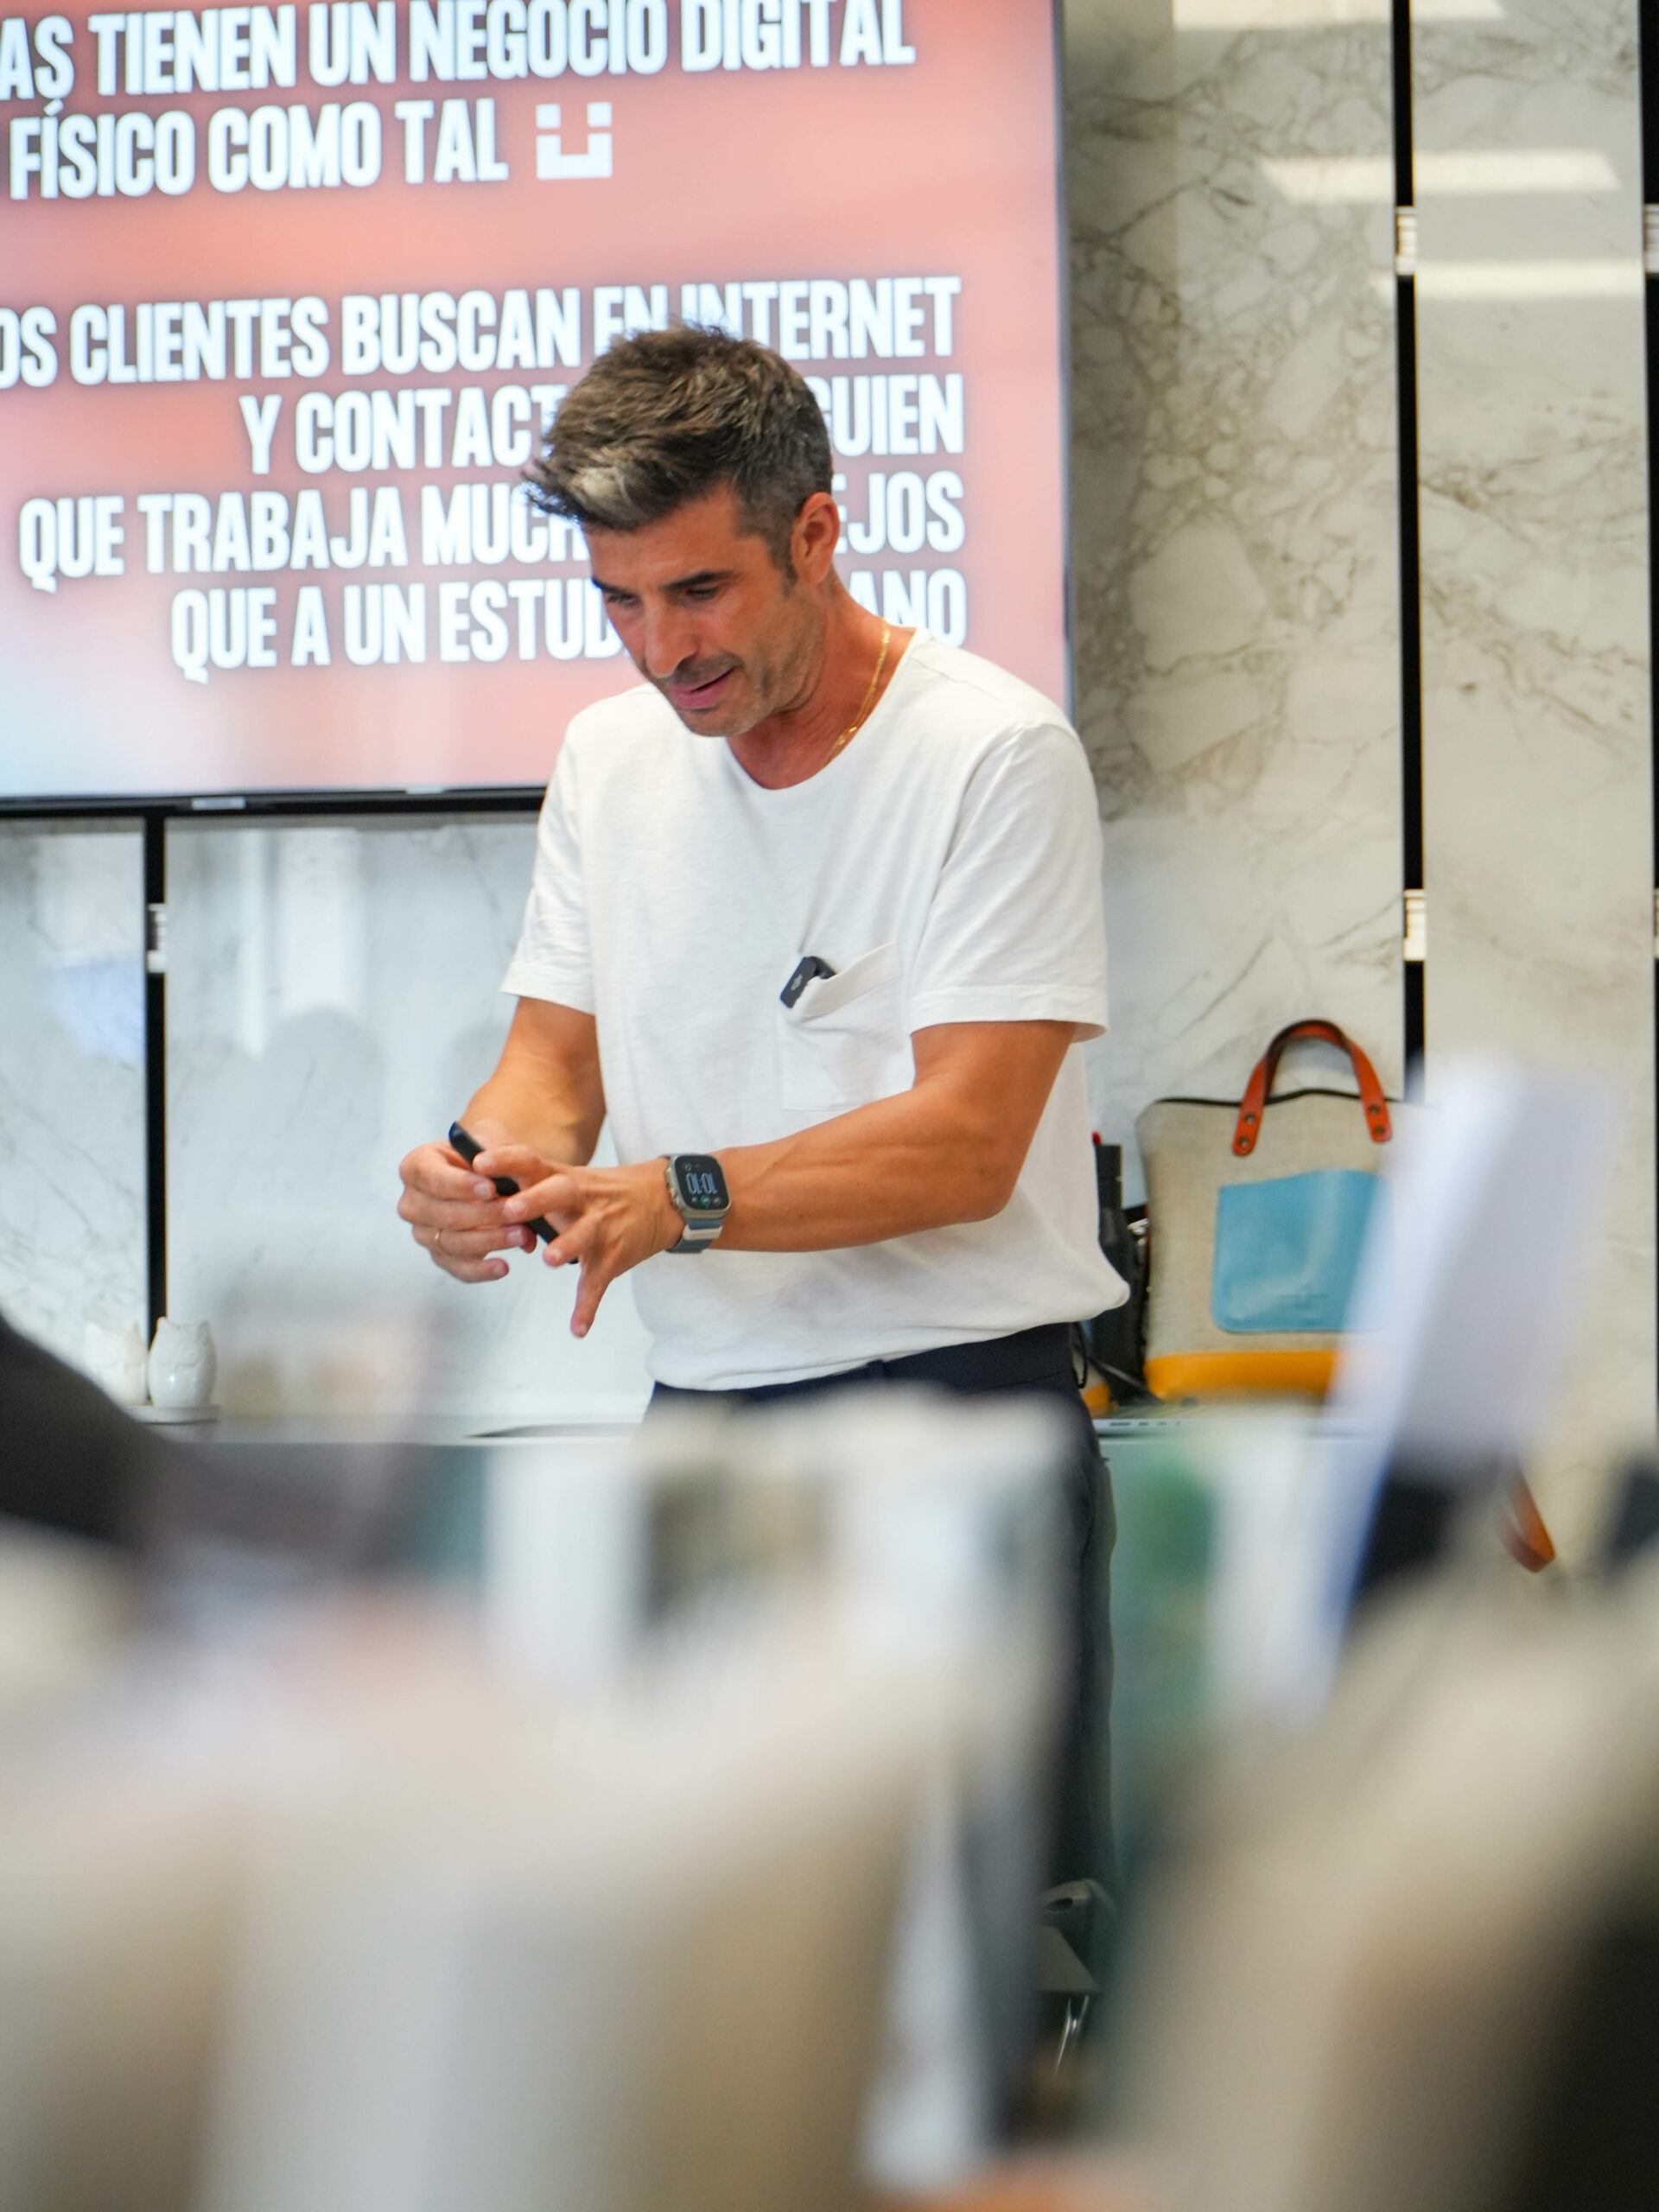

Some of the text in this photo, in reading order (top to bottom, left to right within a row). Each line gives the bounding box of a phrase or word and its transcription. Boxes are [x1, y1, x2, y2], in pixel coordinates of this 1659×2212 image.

[0, 0, 916, 100] AS TIENEN UN NEGOCIO DIGITAL
[10, 98, 508, 200] FÍSICO COMO TAL
[70, 296, 329, 385] CLIENTES
[341, 289, 581, 376] BUSCAN
[239, 395, 282, 474] Y
[19, 496, 124, 594] QUE
[137, 486, 409, 574] TRABAJA
[170, 588, 276, 684] QUE
[290, 586, 331, 666] A
[343, 582, 426, 665] UN
